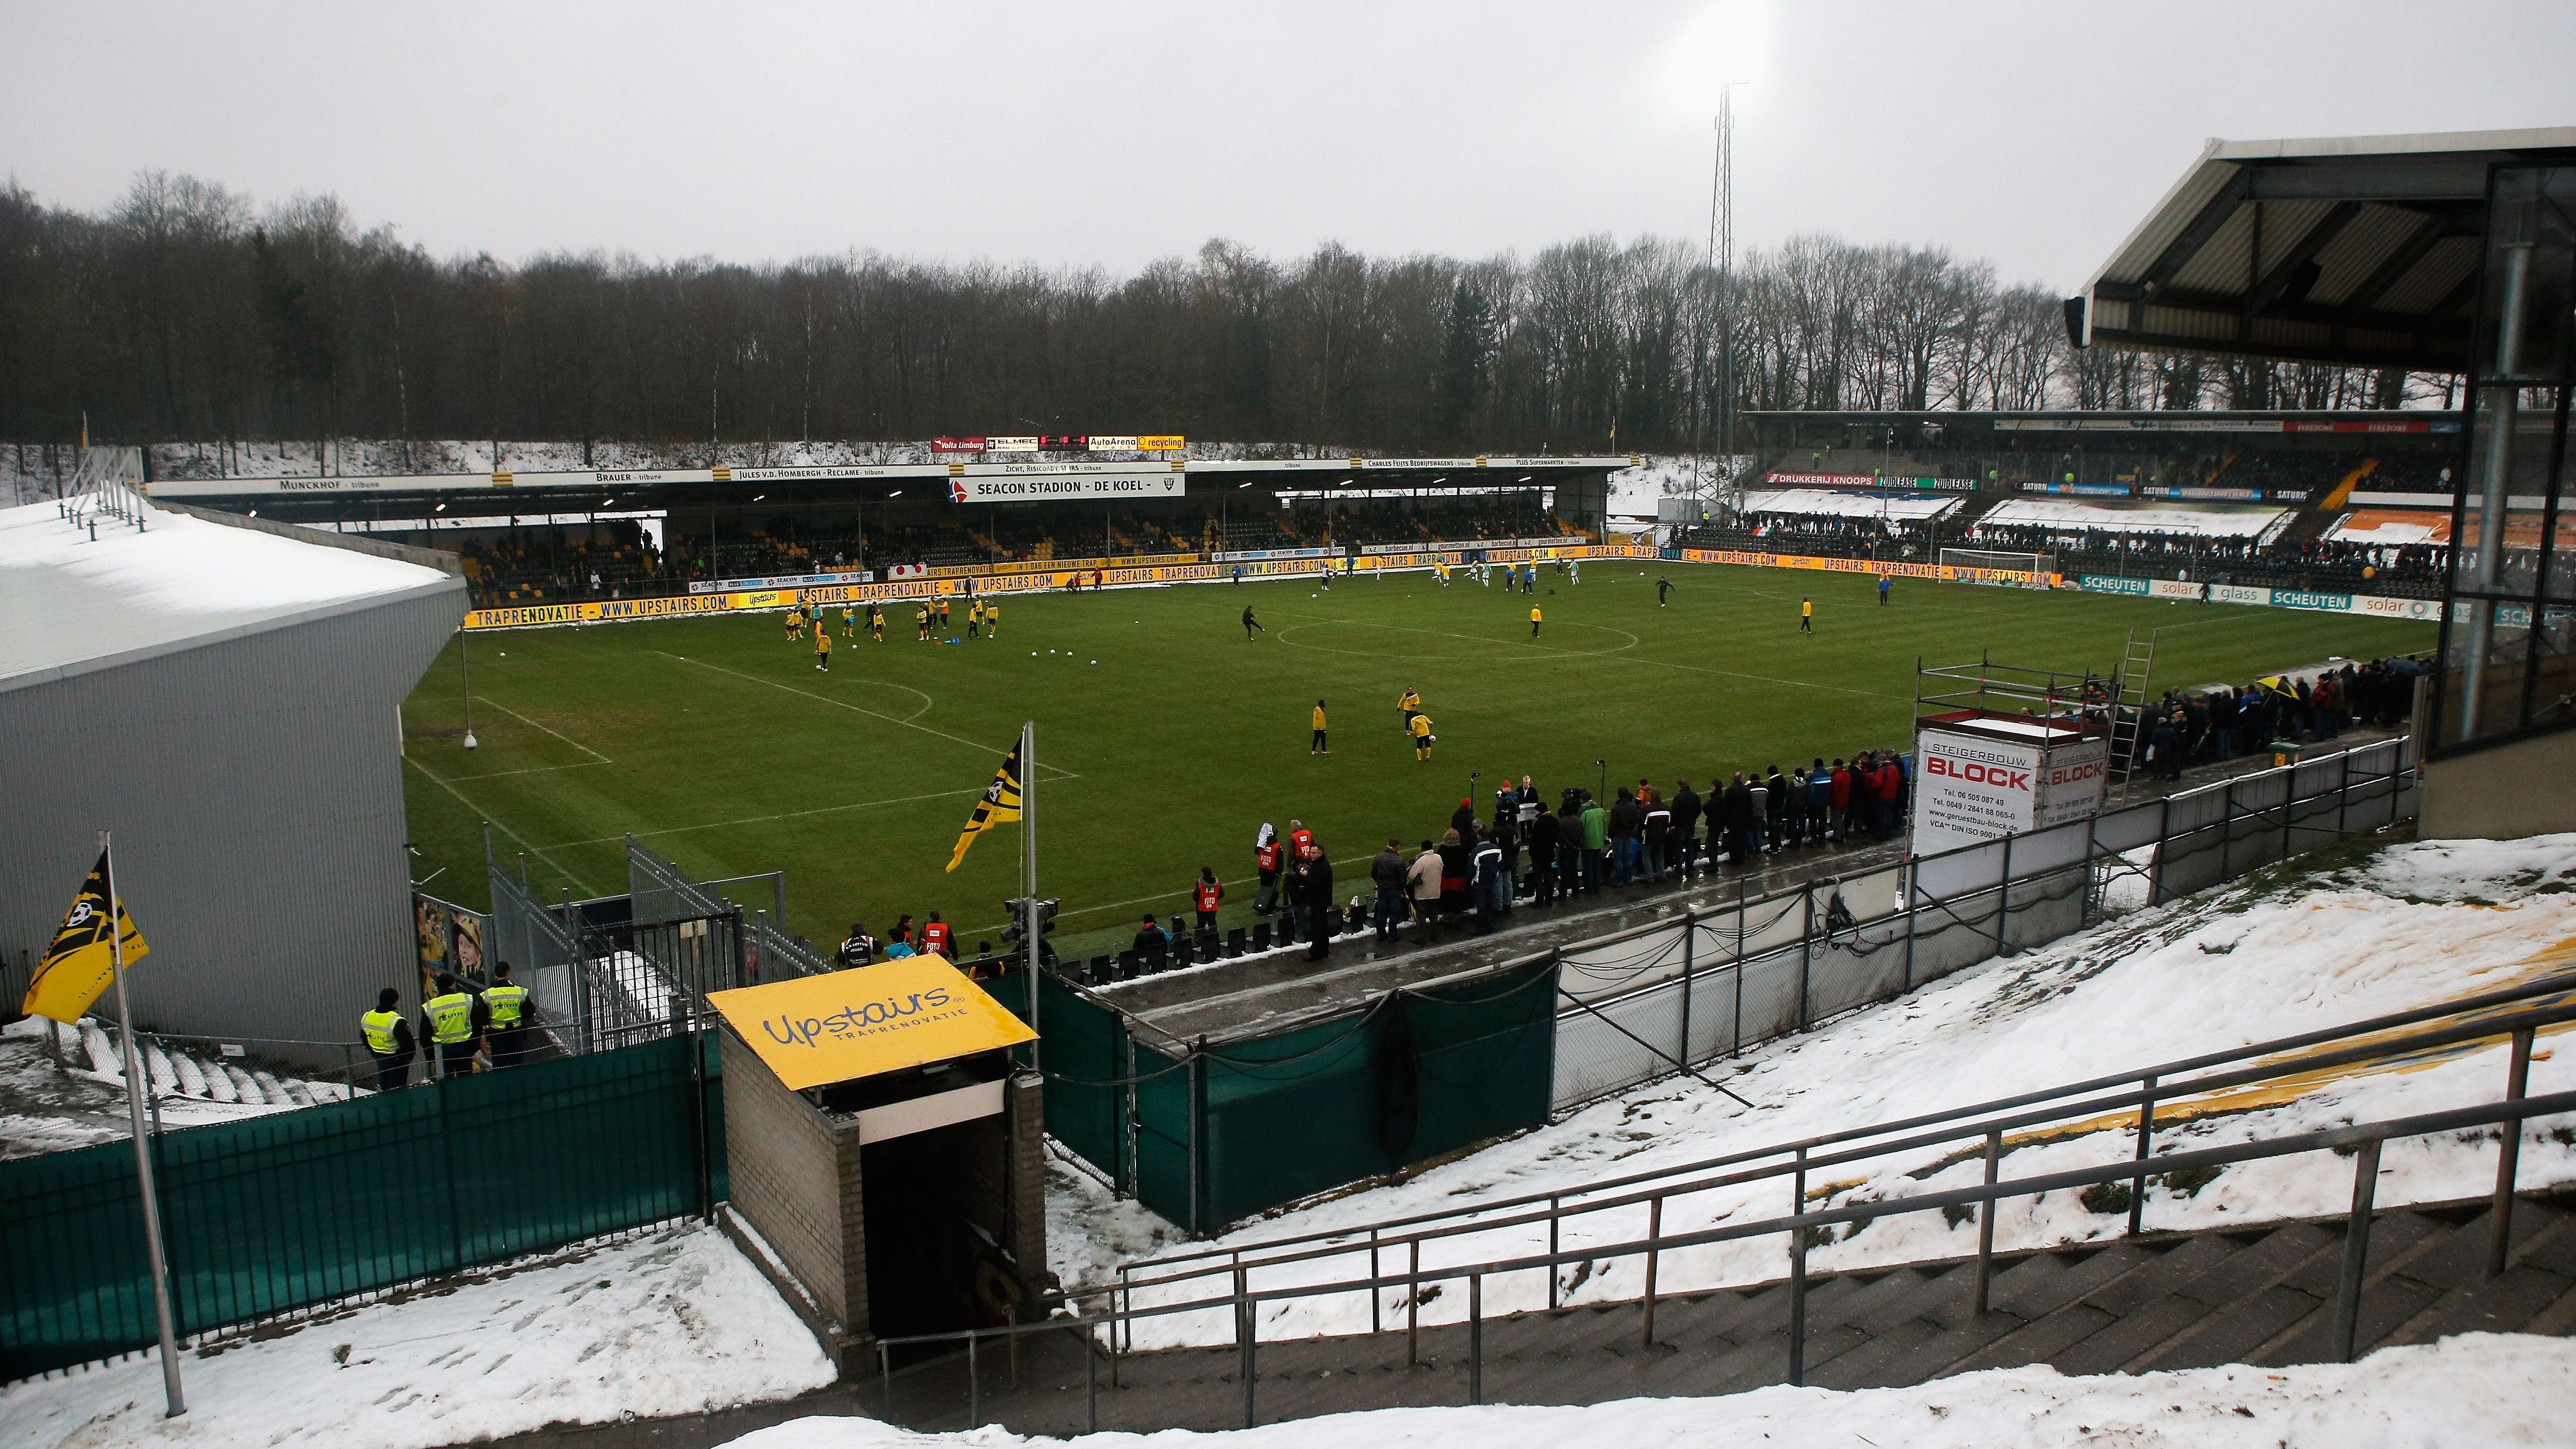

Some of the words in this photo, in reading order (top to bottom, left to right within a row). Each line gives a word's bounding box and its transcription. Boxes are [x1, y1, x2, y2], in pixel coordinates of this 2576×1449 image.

[941, 441, 957, 449] Volta
[959, 441, 984, 450] Limburg
[1148, 437, 1181, 448] recycling
[739, 470, 760, 479] JULES
[778, 469, 822, 478] HOMBERGH
[1005, 465, 1024, 473] ZICHT,
[596, 473, 631, 481] BRAUER
[1779, 475, 1830, 484] DRUKKERIJ
[1833, 477, 1872, 485] KNOOPS
[1879, 477, 1917, 487] ZUIDLEASE
[280, 480, 341, 490] MUNCKHOF
[978, 483, 1025, 495] SEACON
[1030, 481, 1081, 493] STADION
[1094, 481, 1109, 491] DE
[1113, 480, 1143, 491] KOEL
[1934, 479, 1973, 490] ZUIDLEASE
[2023, 482, 2047, 491] SATURN
[2143, 486, 2170, 495] SATURN
[2277, 491, 2307, 499] SATURN
[1385, 544, 1414, 552] barbecue.nl
[1438, 542, 1470, 550] gourmetten.nl
[1538, 538, 1568, 546] gourmetten.nl
[1121, 555, 1179, 565] WWW.UPSTAIRS.COM
[1372, 556, 1408, 567] USTAIRS
[1414, 551, 1470, 565] TRAPRNOVATIE
[1587, 547, 1625, 556] UPSTAIRS
[1632, 546, 1691, 560] TRAPRENOVATIE
[1700, 551, 1777, 566] WWW.UPSTAIRS.COM
[944, 566, 992, 575] TRAPRENOVATIE
[1031, 562, 1042, 570] DAG
[1044, 561, 1055, 569] EEN
[1057, 560, 1080, 568] NIEUWE
[1824, 559, 1864, 571] UPSTAIRS
[1871, 562, 1940, 577] TRAPRENOVATIE
[1109, 569, 1153, 582] UPSTAIRS
[1160, 563, 1229, 580] TRAPRENOVATIE
[1241, 561, 1325, 575] WWW.UPSTAIRS.COM
[2084, 576, 2147, 592] SCHEUTEN
[2162, 581, 2194, 595] solar
[857, 582, 939, 599] TRAPRENOVATIE
[2221, 585, 2258, 601] glass
[750, 593, 776, 606] Upstairs
[2274, 592, 2347, 608] SCHEUTEN
[2366, 599, 2405, 612] solar
[477, 605, 582, 626] TRAPRENOVATIE
[600, 595, 727, 617] WWW.UPSTAIRS.COM
[1933, 744, 2027, 766] STEIGERBOUW
[1927, 756, 2030, 792] BLOCK
[2051, 762, 2103, 786] BLOCK
[1944, 789, 1956, 797] Tel.
[1968, 793, 1980, 801] 505
[1933, 797, 1944, 806] Tel.
[1946, 800, 1962, 809] 0049
[1996, 810, 2015, 819] 065-0
[1929, 809, 2018, 832] www.geruestbau-block.de
[1952, 824, 1964, 833] DIN
[1966, 827, 1978, 836] ISO
[1261, 855, 1272, 863] FOTO
[926, 942, 940, 951] FOTO
[762, 987, 950, 1048] Upstairs
[835, 1008, 968, 1041] TRAPRENOVATIE
